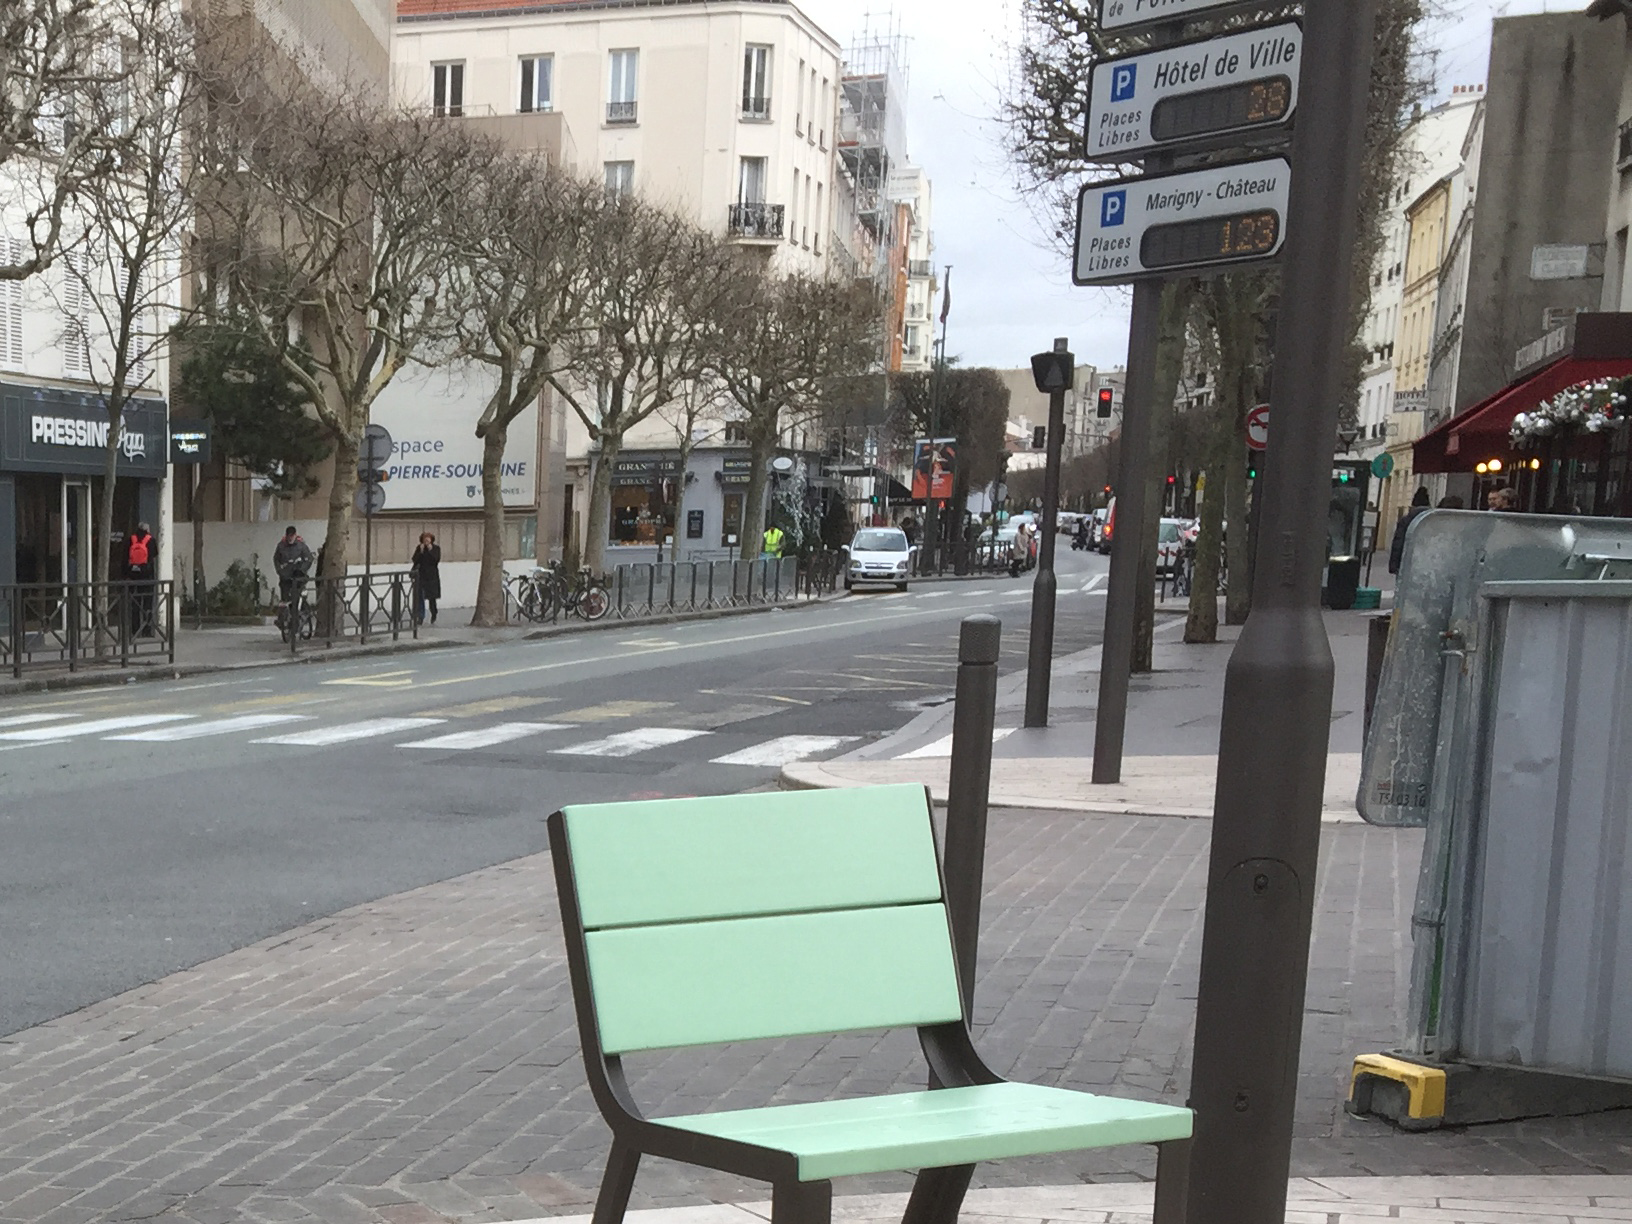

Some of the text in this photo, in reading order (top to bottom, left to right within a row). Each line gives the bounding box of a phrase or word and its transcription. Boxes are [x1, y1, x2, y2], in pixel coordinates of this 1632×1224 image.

[1154, 54, 1209, 90] Hôtel
[1215, 49, 1239, 77] de
[1250, 37, 1296, 70] Ville
[1101, 110, 1142, 129] Places
[1099, 128, 1140, 149] Libres
[1146, 189, 1204, 212] Marigny
[1216, 177, 1277, 201] Château
[1221, 214, 1275, 254] 123
[1090, 236, 1131, 254] Places
[1089, 256, 1130, 272] Libres
[117, 414, 147, 463] Aqua
[391, 440, 444, 461] space
